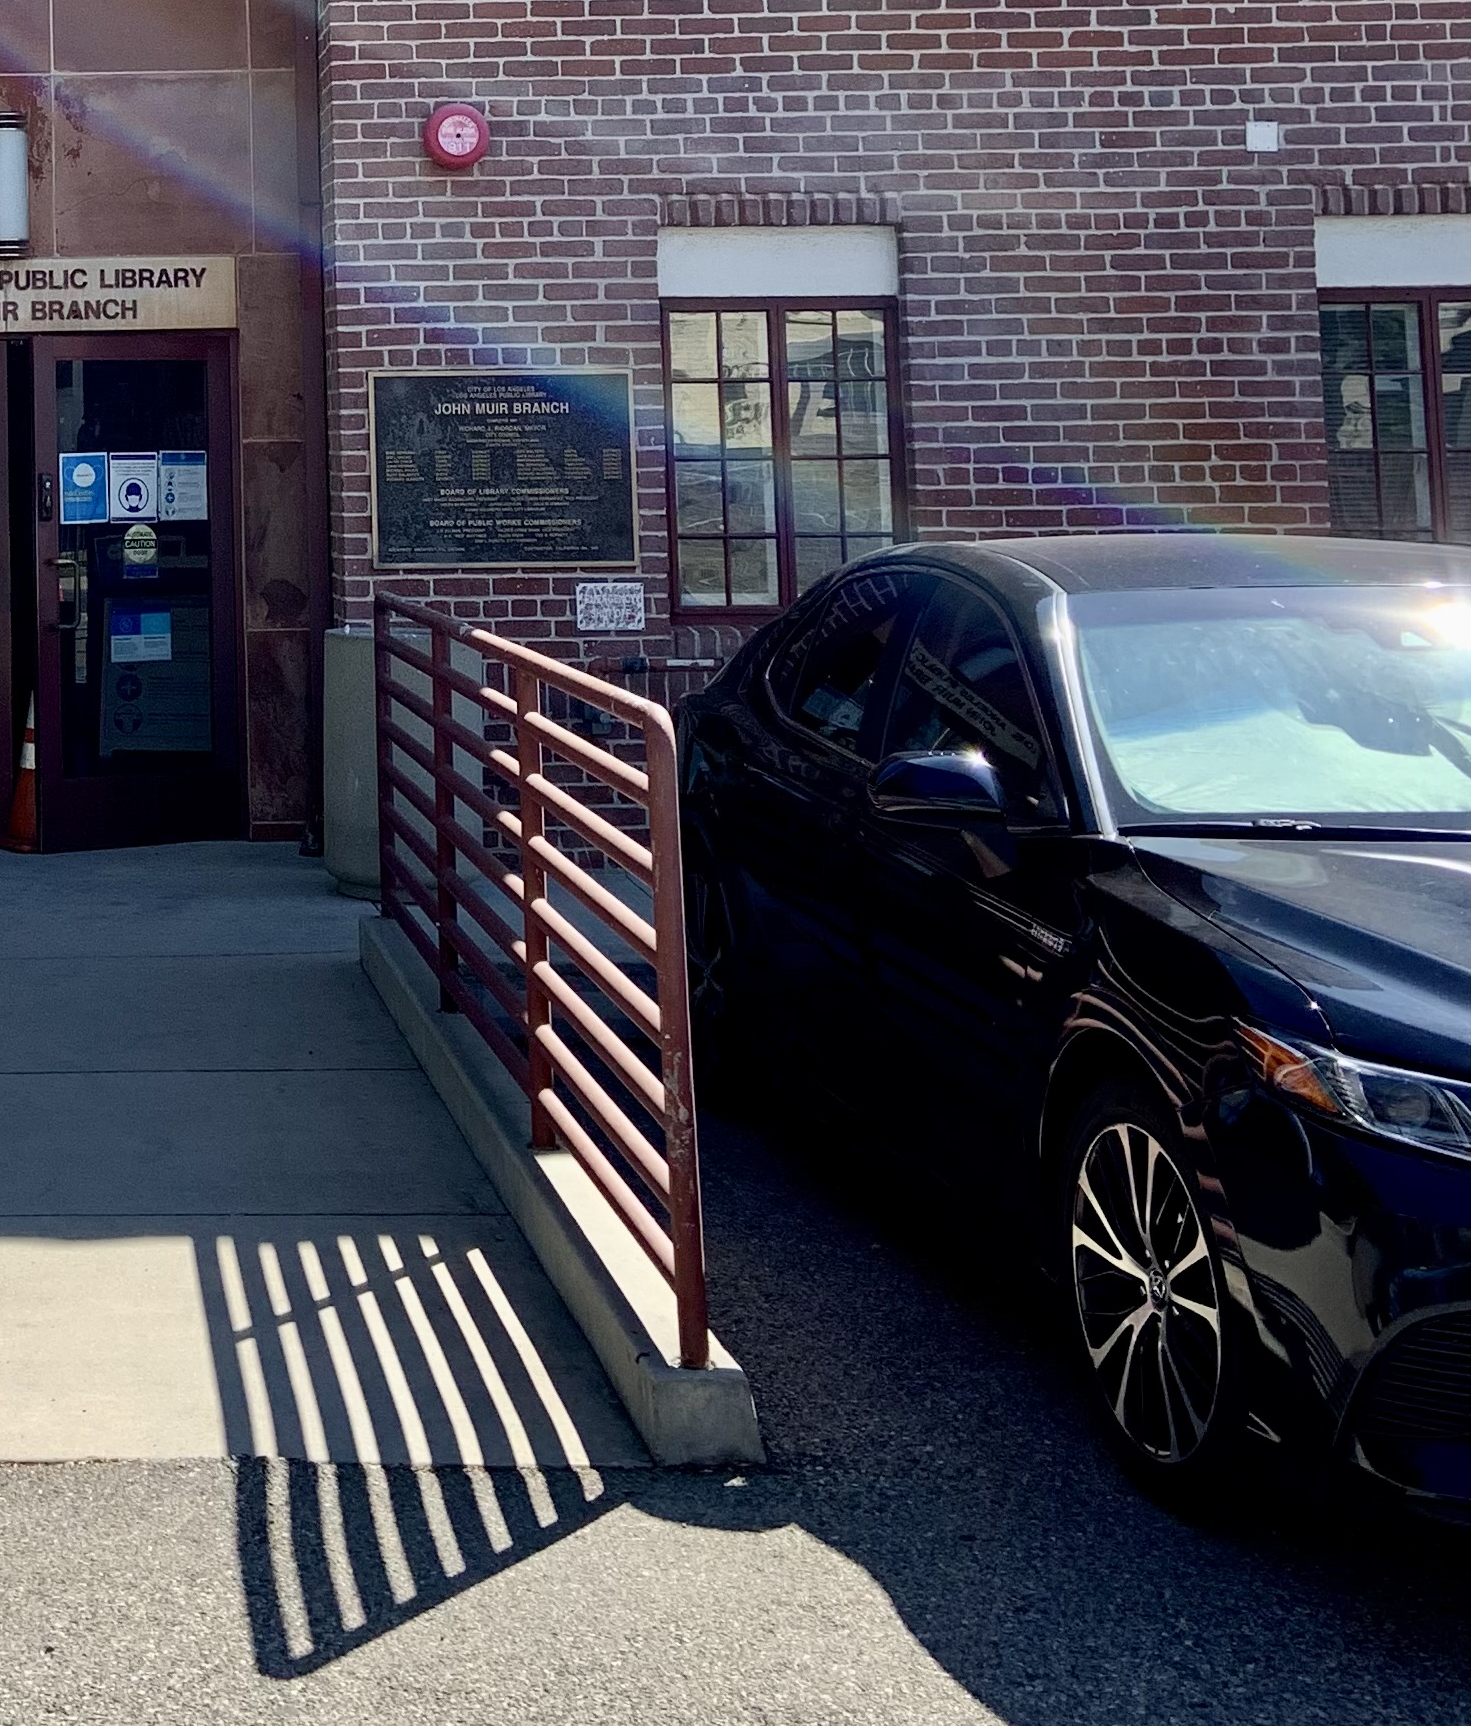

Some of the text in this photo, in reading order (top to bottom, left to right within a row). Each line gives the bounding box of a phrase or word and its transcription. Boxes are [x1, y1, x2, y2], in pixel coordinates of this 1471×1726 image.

[99, 267, 207, 289] LIBRARY
[30, 299, 138, 321] BRANCH
[434, 401, 570, 415] JOHN MUIR BRANCH
[125, 540, 156, 548] CAUTION
